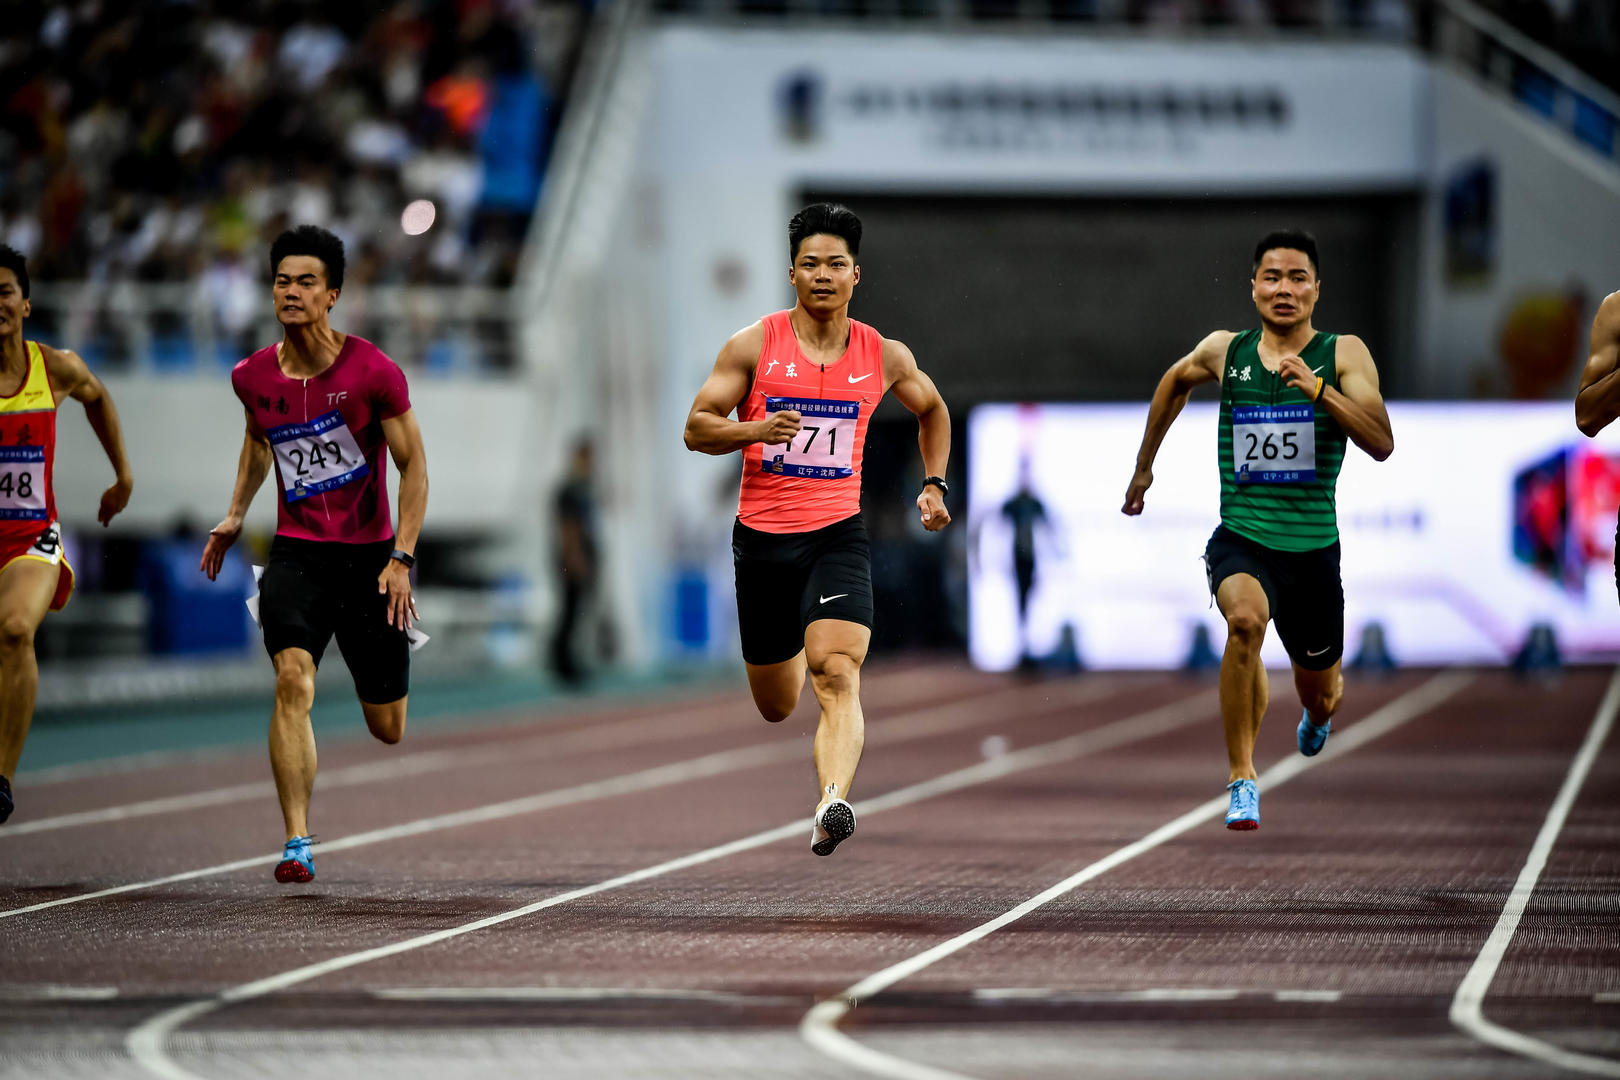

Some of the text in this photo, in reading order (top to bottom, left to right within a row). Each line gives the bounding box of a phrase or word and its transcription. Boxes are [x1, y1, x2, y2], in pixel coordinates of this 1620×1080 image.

[765, 360, 798, 378] 广东
[1228, 365, 1252, 382] 江苏
[289, 440, 342, 476] 249
[1245, 432, 1299, 461] 265
